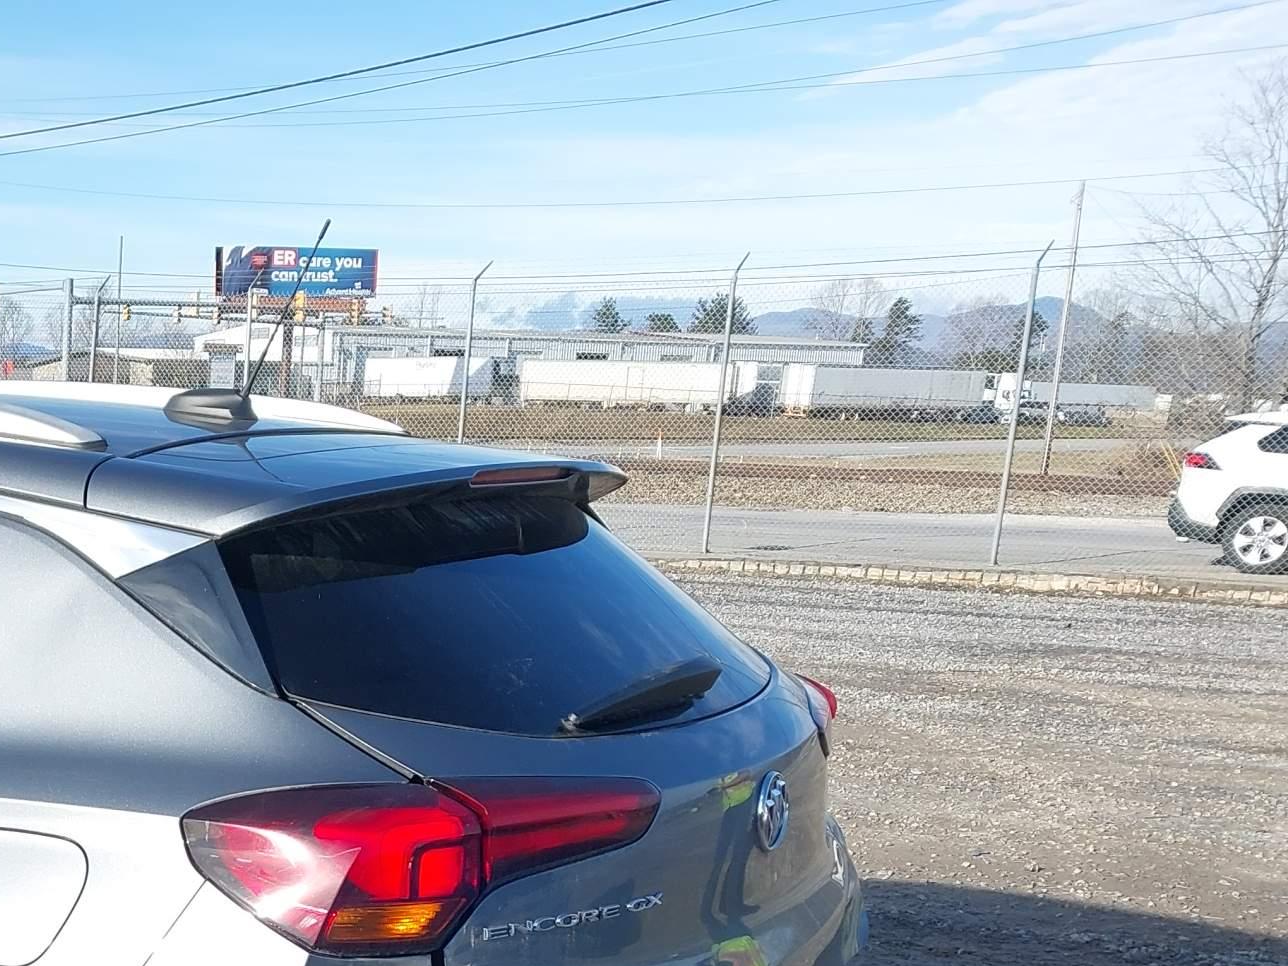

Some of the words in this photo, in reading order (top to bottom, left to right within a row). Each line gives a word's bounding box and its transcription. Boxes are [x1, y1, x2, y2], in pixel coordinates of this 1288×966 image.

[273, 250, 296, 266] ER
[299, 256, 332, 268] care
[335, 256, 362, 271] you
[271, 270, 298, 282] can
[483, 904, 621, 941] ENCORE
[626, 892, 664, 912] GX
